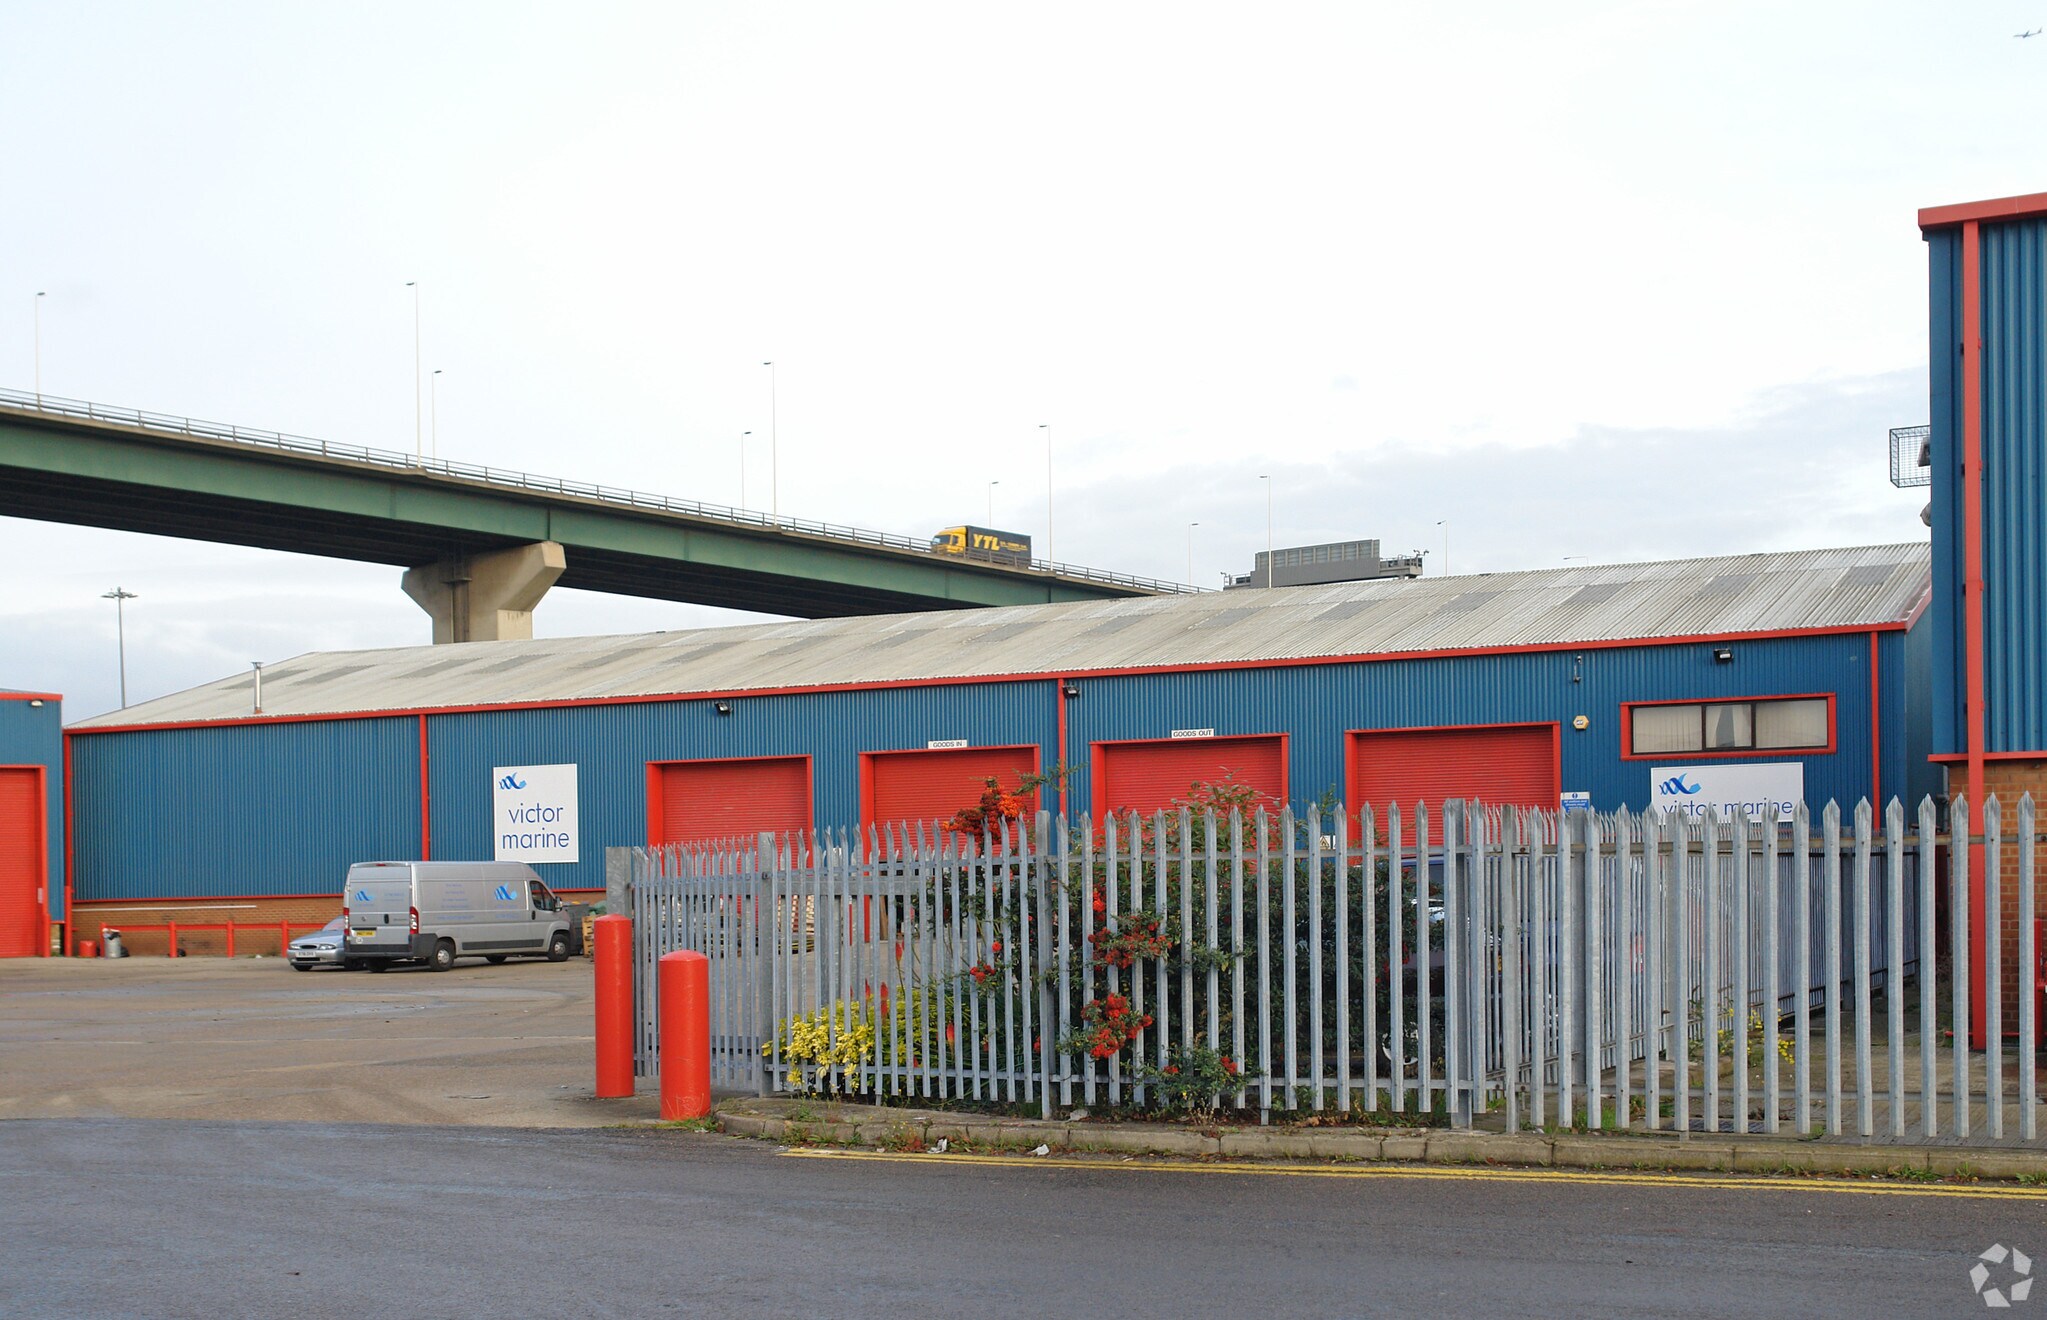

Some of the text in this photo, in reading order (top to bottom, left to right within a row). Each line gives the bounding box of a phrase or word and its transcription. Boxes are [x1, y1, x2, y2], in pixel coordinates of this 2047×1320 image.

[973, 534, 1000, 551] YTL
[1173, 729, 1212, 738] GOODS OUT
[508, 803, 564, 824] victor
[1662, 797, 1793, 817] vito marine
[502, 827, 570, 849] marine
